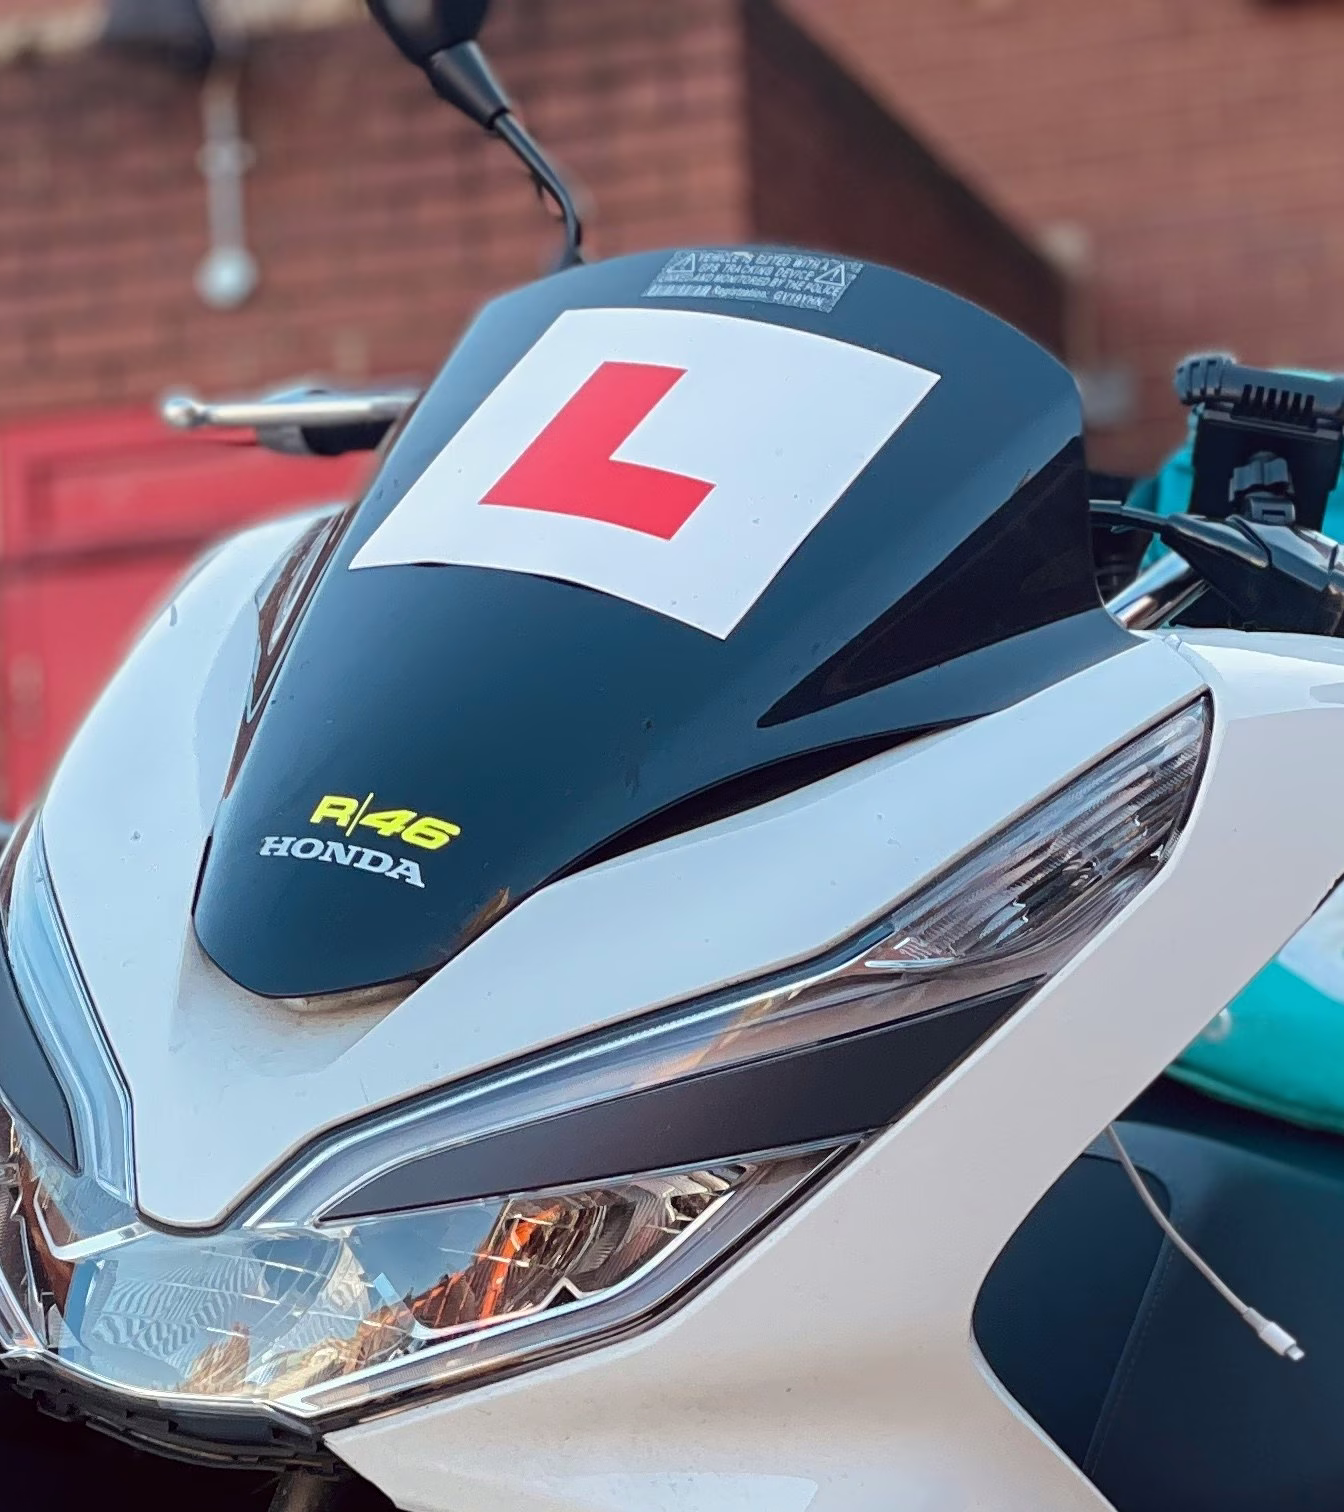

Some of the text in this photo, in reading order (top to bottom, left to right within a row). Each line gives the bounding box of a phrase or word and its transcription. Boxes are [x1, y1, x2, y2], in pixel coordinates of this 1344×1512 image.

[698, 263, 815, 281] GPS TRACKING DEVICE
[793, 256, 821, 270] WITH
[714, 273, 771, 286] MONITORED
[769, 277, 786, 288] BY
[785, 279, 806, 291] THE
[804, 281, 842, 297] POLICE
[478, 360, 717, 541] L
[259, 835, 425, 889] HONDA
